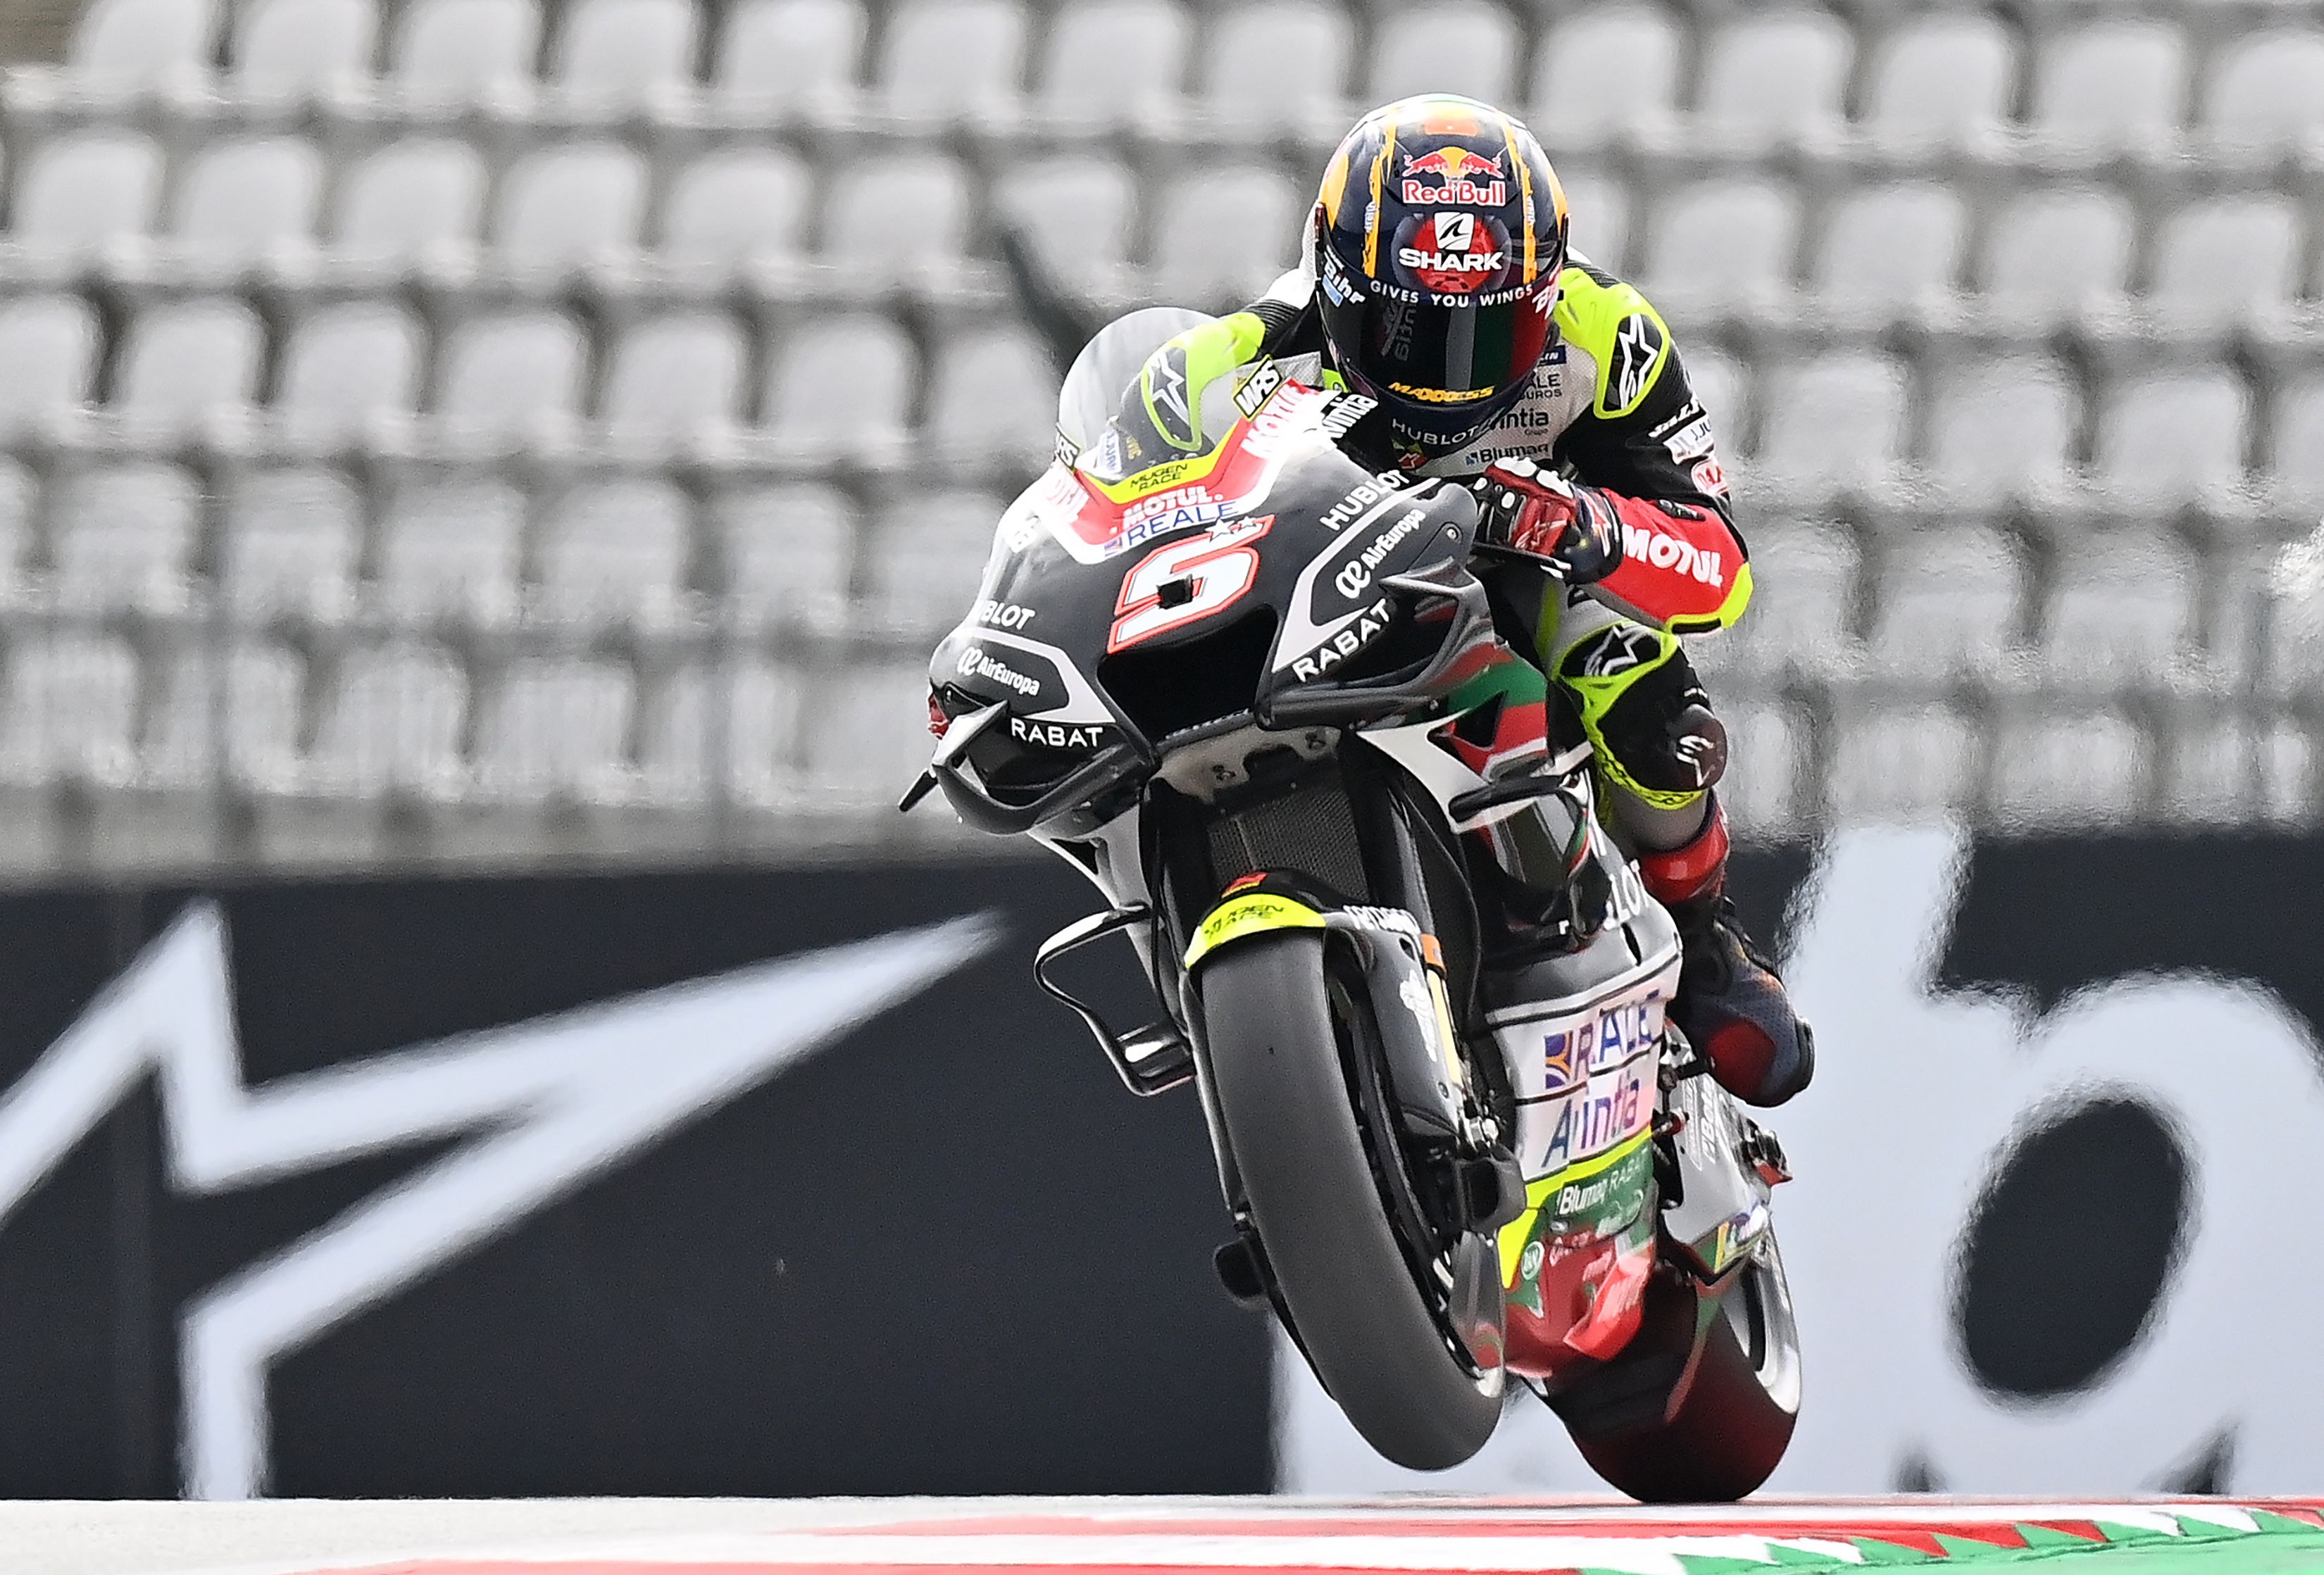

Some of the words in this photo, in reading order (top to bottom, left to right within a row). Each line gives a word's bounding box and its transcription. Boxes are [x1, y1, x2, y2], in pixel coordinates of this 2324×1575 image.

[1402, 180, 1453, 204] Red
[1456, 180, 1506, 206] Bull
[1399, 248, 1503, 272] SHARK
[1370, 280, 1418, 304] GIVES
[1431, 294, 1469, 308] YOU
[1480, 284, 1533, 307] WINGS
[1235, 360, 1282, 415] WRS
[1392, 418, 1479, 445] HUBLOT
[1130, 463, 1188, 489] MUGEN
[1139, 471, 1182, 492] RACE
[1320, 468, 1411, 531] HUBLOT
[1127, 501, 1239, 546] REALE
[1621, 525, 1724, 588] MOTUL
[1292, 598, 1390, 683] RABAT
[1011, 718, 1104, 748] RABAT
